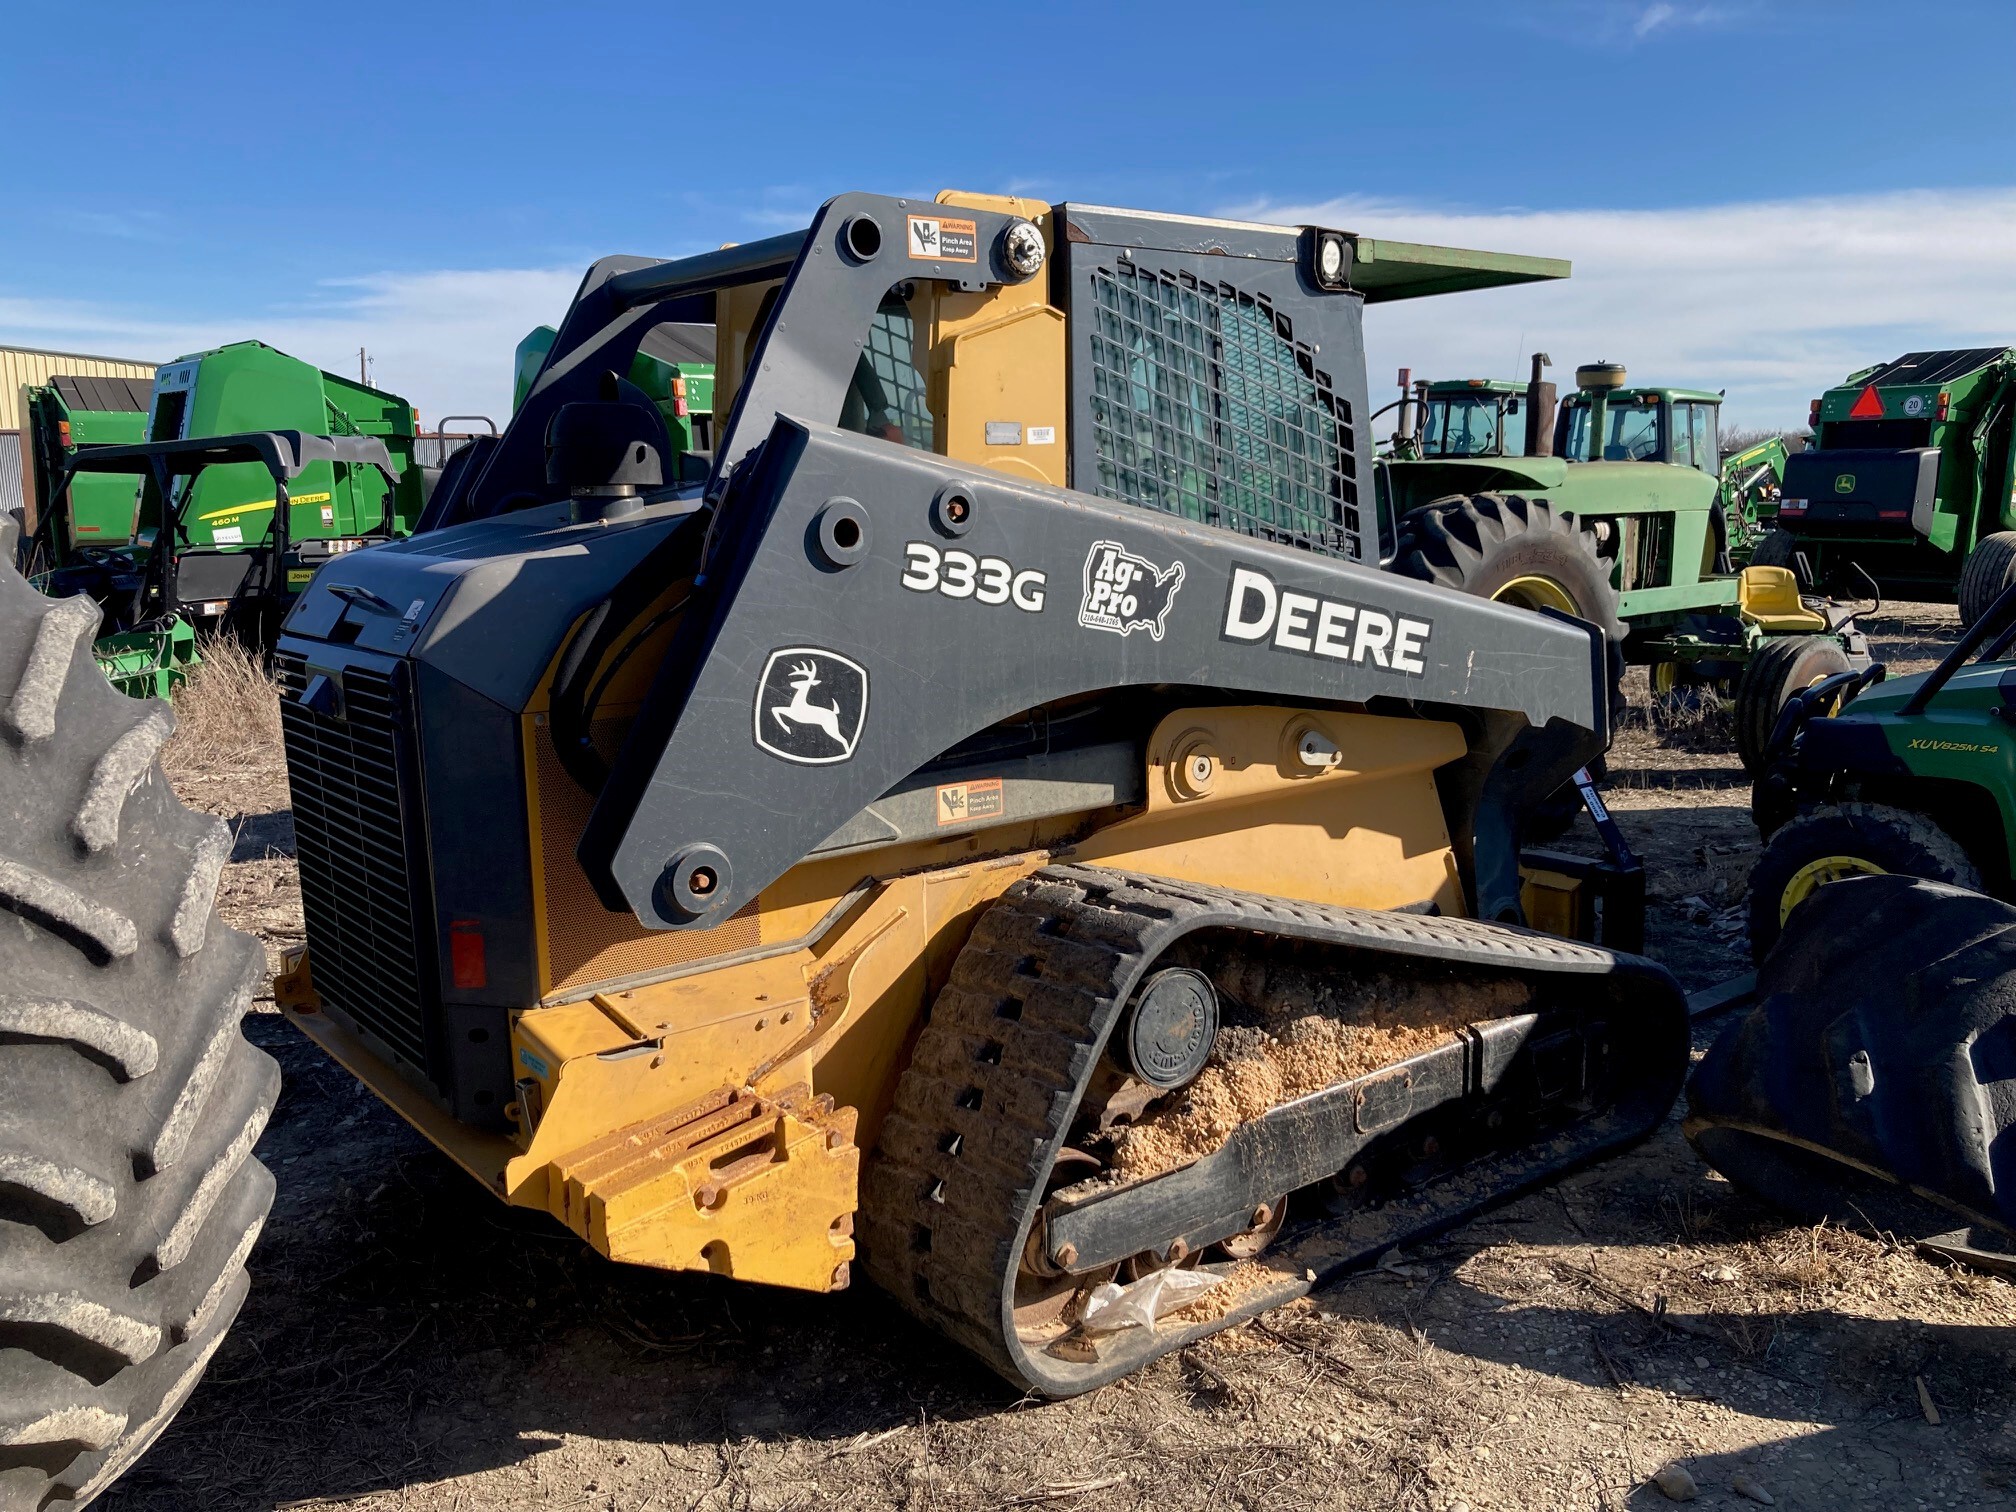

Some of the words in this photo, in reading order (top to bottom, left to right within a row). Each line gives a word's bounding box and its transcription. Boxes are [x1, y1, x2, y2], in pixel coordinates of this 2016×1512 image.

[947, 222, 973, 231] WARNING
[942, 236, 958, 245] Pinch
[959, 238, 972, 246] Area
[942, 246, 954, 254] Keep
[956, 247, 968, 255] Away
[1908, 400, 1918, 409] 20
[299, 495, 325, 503] DEERE
[212, 518, 230, 526] 460
[902, 542, 1047, 612] 333G
[1088, 580, 1138, 617] Pro
[1224, 567, 1431, 674] DEERE
[1907, 738, 1979, 752] XUV825M
[1980, 745, 1999, 753] S4
[974, 780, 1000, 789] WARNING
[970, 796, 985, 804] Pinch
